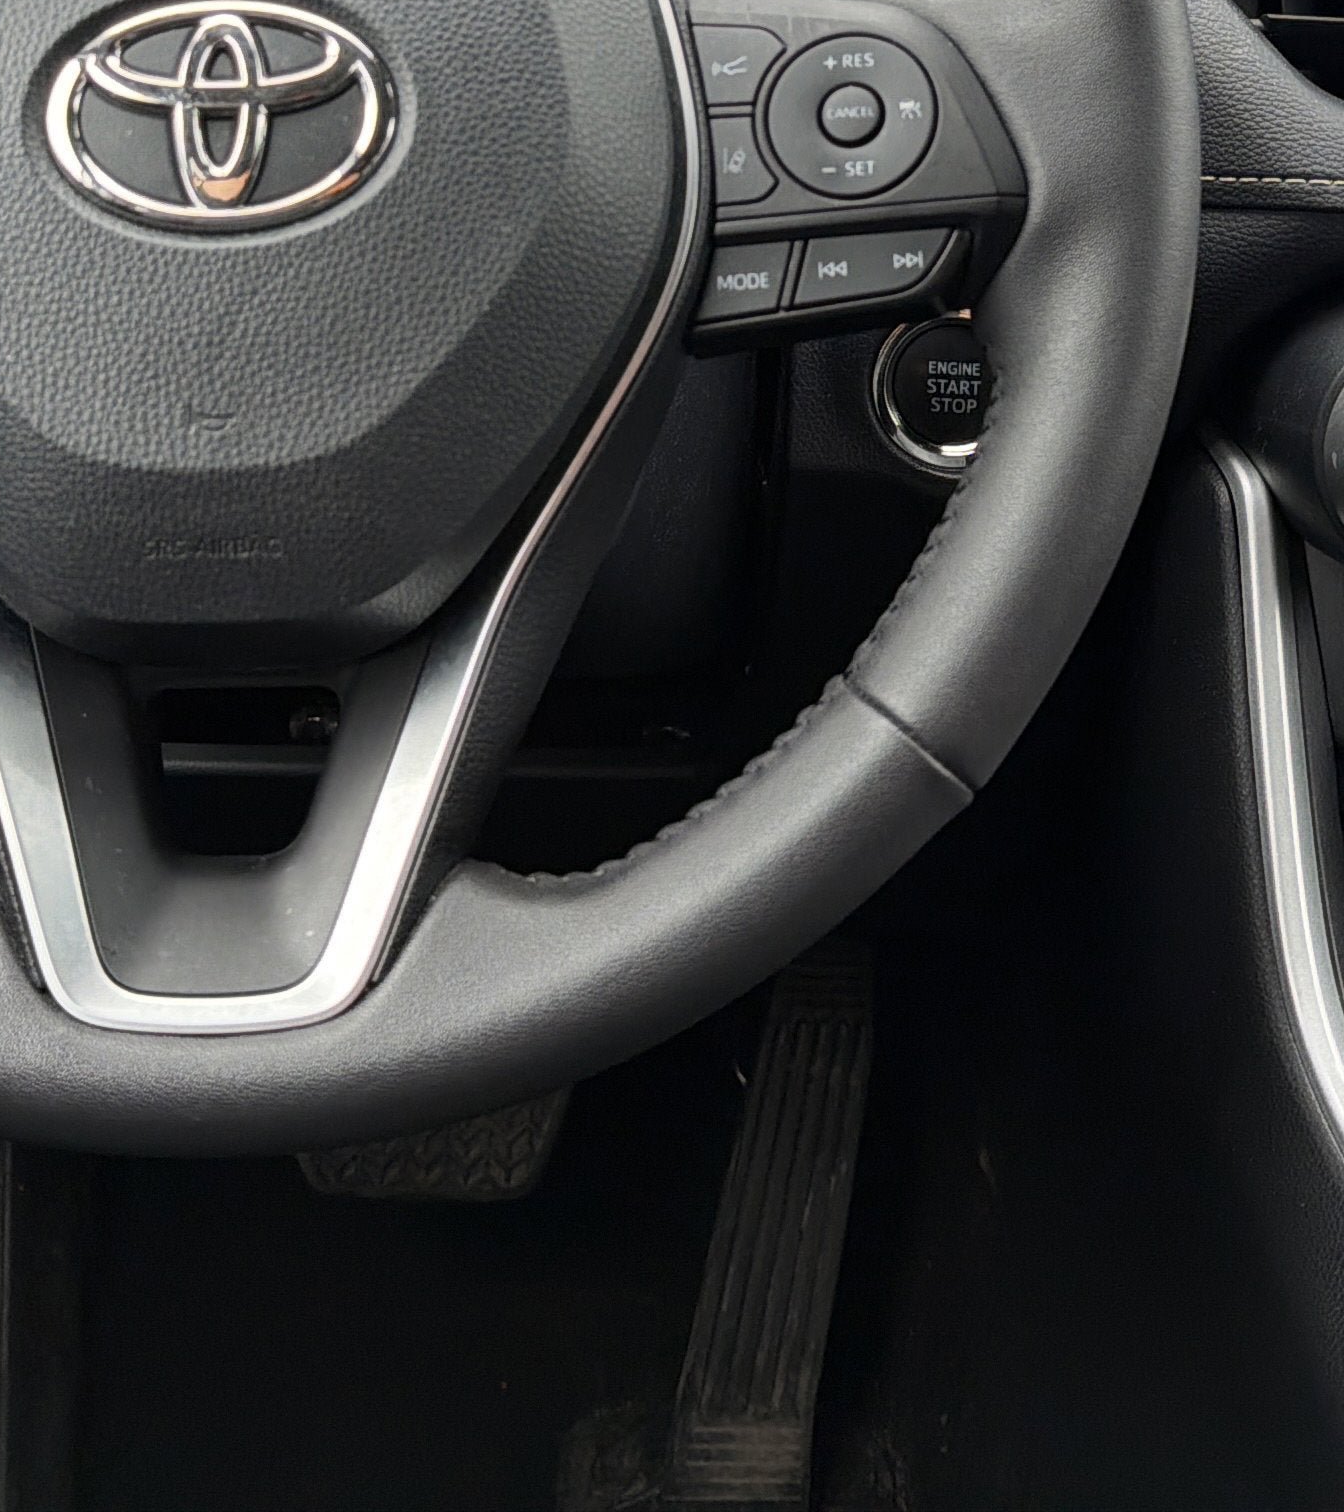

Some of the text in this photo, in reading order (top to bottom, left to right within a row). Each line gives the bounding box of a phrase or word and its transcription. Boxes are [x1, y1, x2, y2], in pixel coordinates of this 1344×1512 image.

[842, 52, 875, 68] RES
[825, 106, 875, 120] CANCEL
[844, 160, 875, 177] SET
[716, 271, 770, 291] MODE
[928, 360, 981, 377] ENGINE
[927, 378, 981, 395] START
[930, 397, 978, 414] STOP
